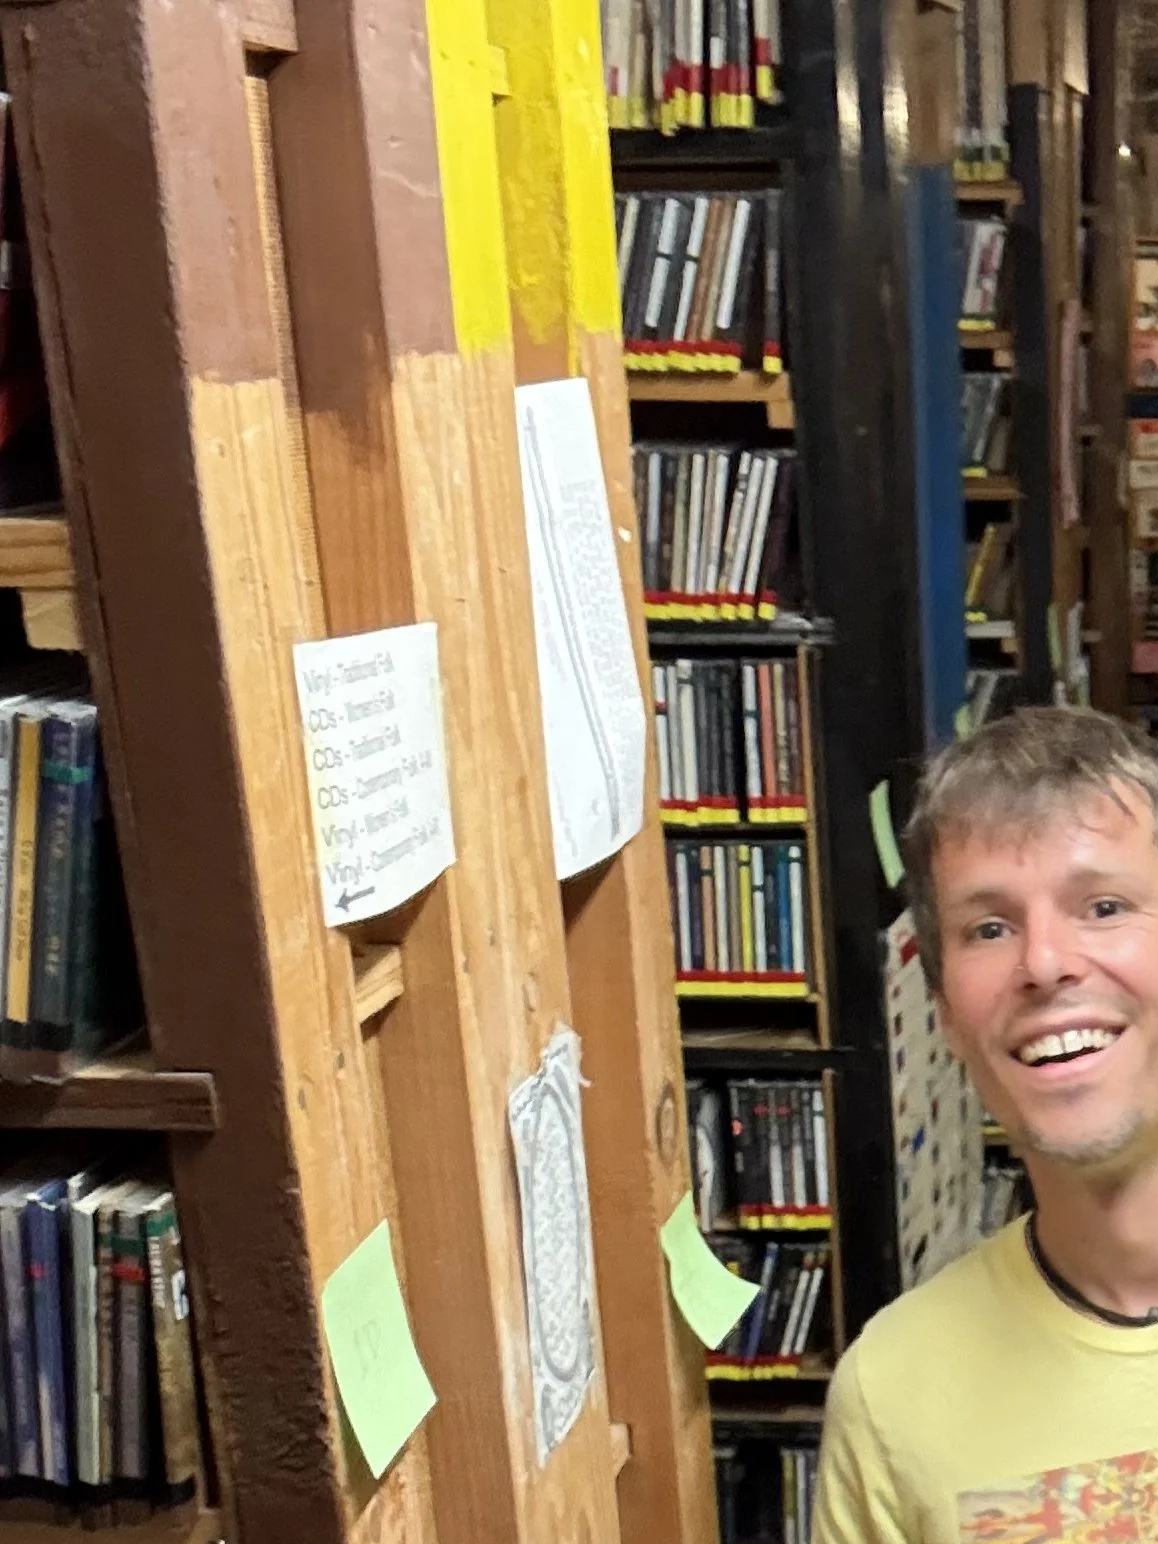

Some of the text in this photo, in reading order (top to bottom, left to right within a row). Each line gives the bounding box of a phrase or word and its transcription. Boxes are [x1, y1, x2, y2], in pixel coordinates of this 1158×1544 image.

[309, 708, 338, 733] CDs
[313, 746, 344, 771] CDs
[317, 785, 348, 810] CDs
